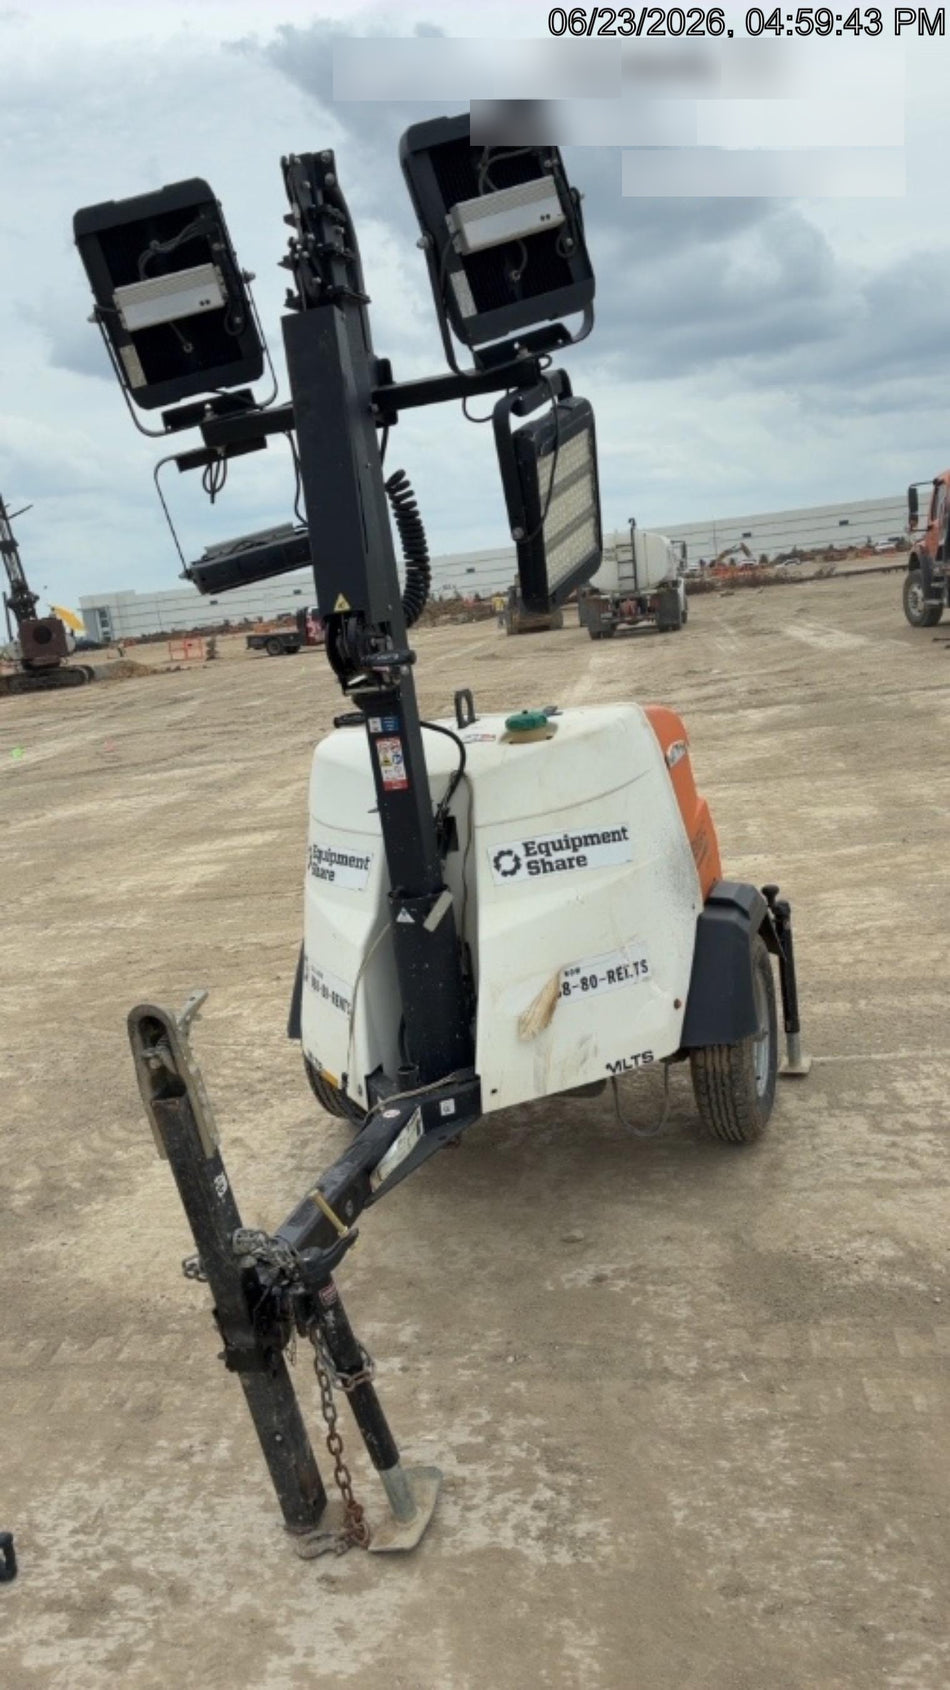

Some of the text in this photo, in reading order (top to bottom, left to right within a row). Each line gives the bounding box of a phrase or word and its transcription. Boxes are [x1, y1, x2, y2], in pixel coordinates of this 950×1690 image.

[522, 826, 630, 857] Equipment
[313, 844, 371, 870] Equipment
[527, 854, 588, 876] Share
[557, 959, 649, 998] 8-80-RETS
